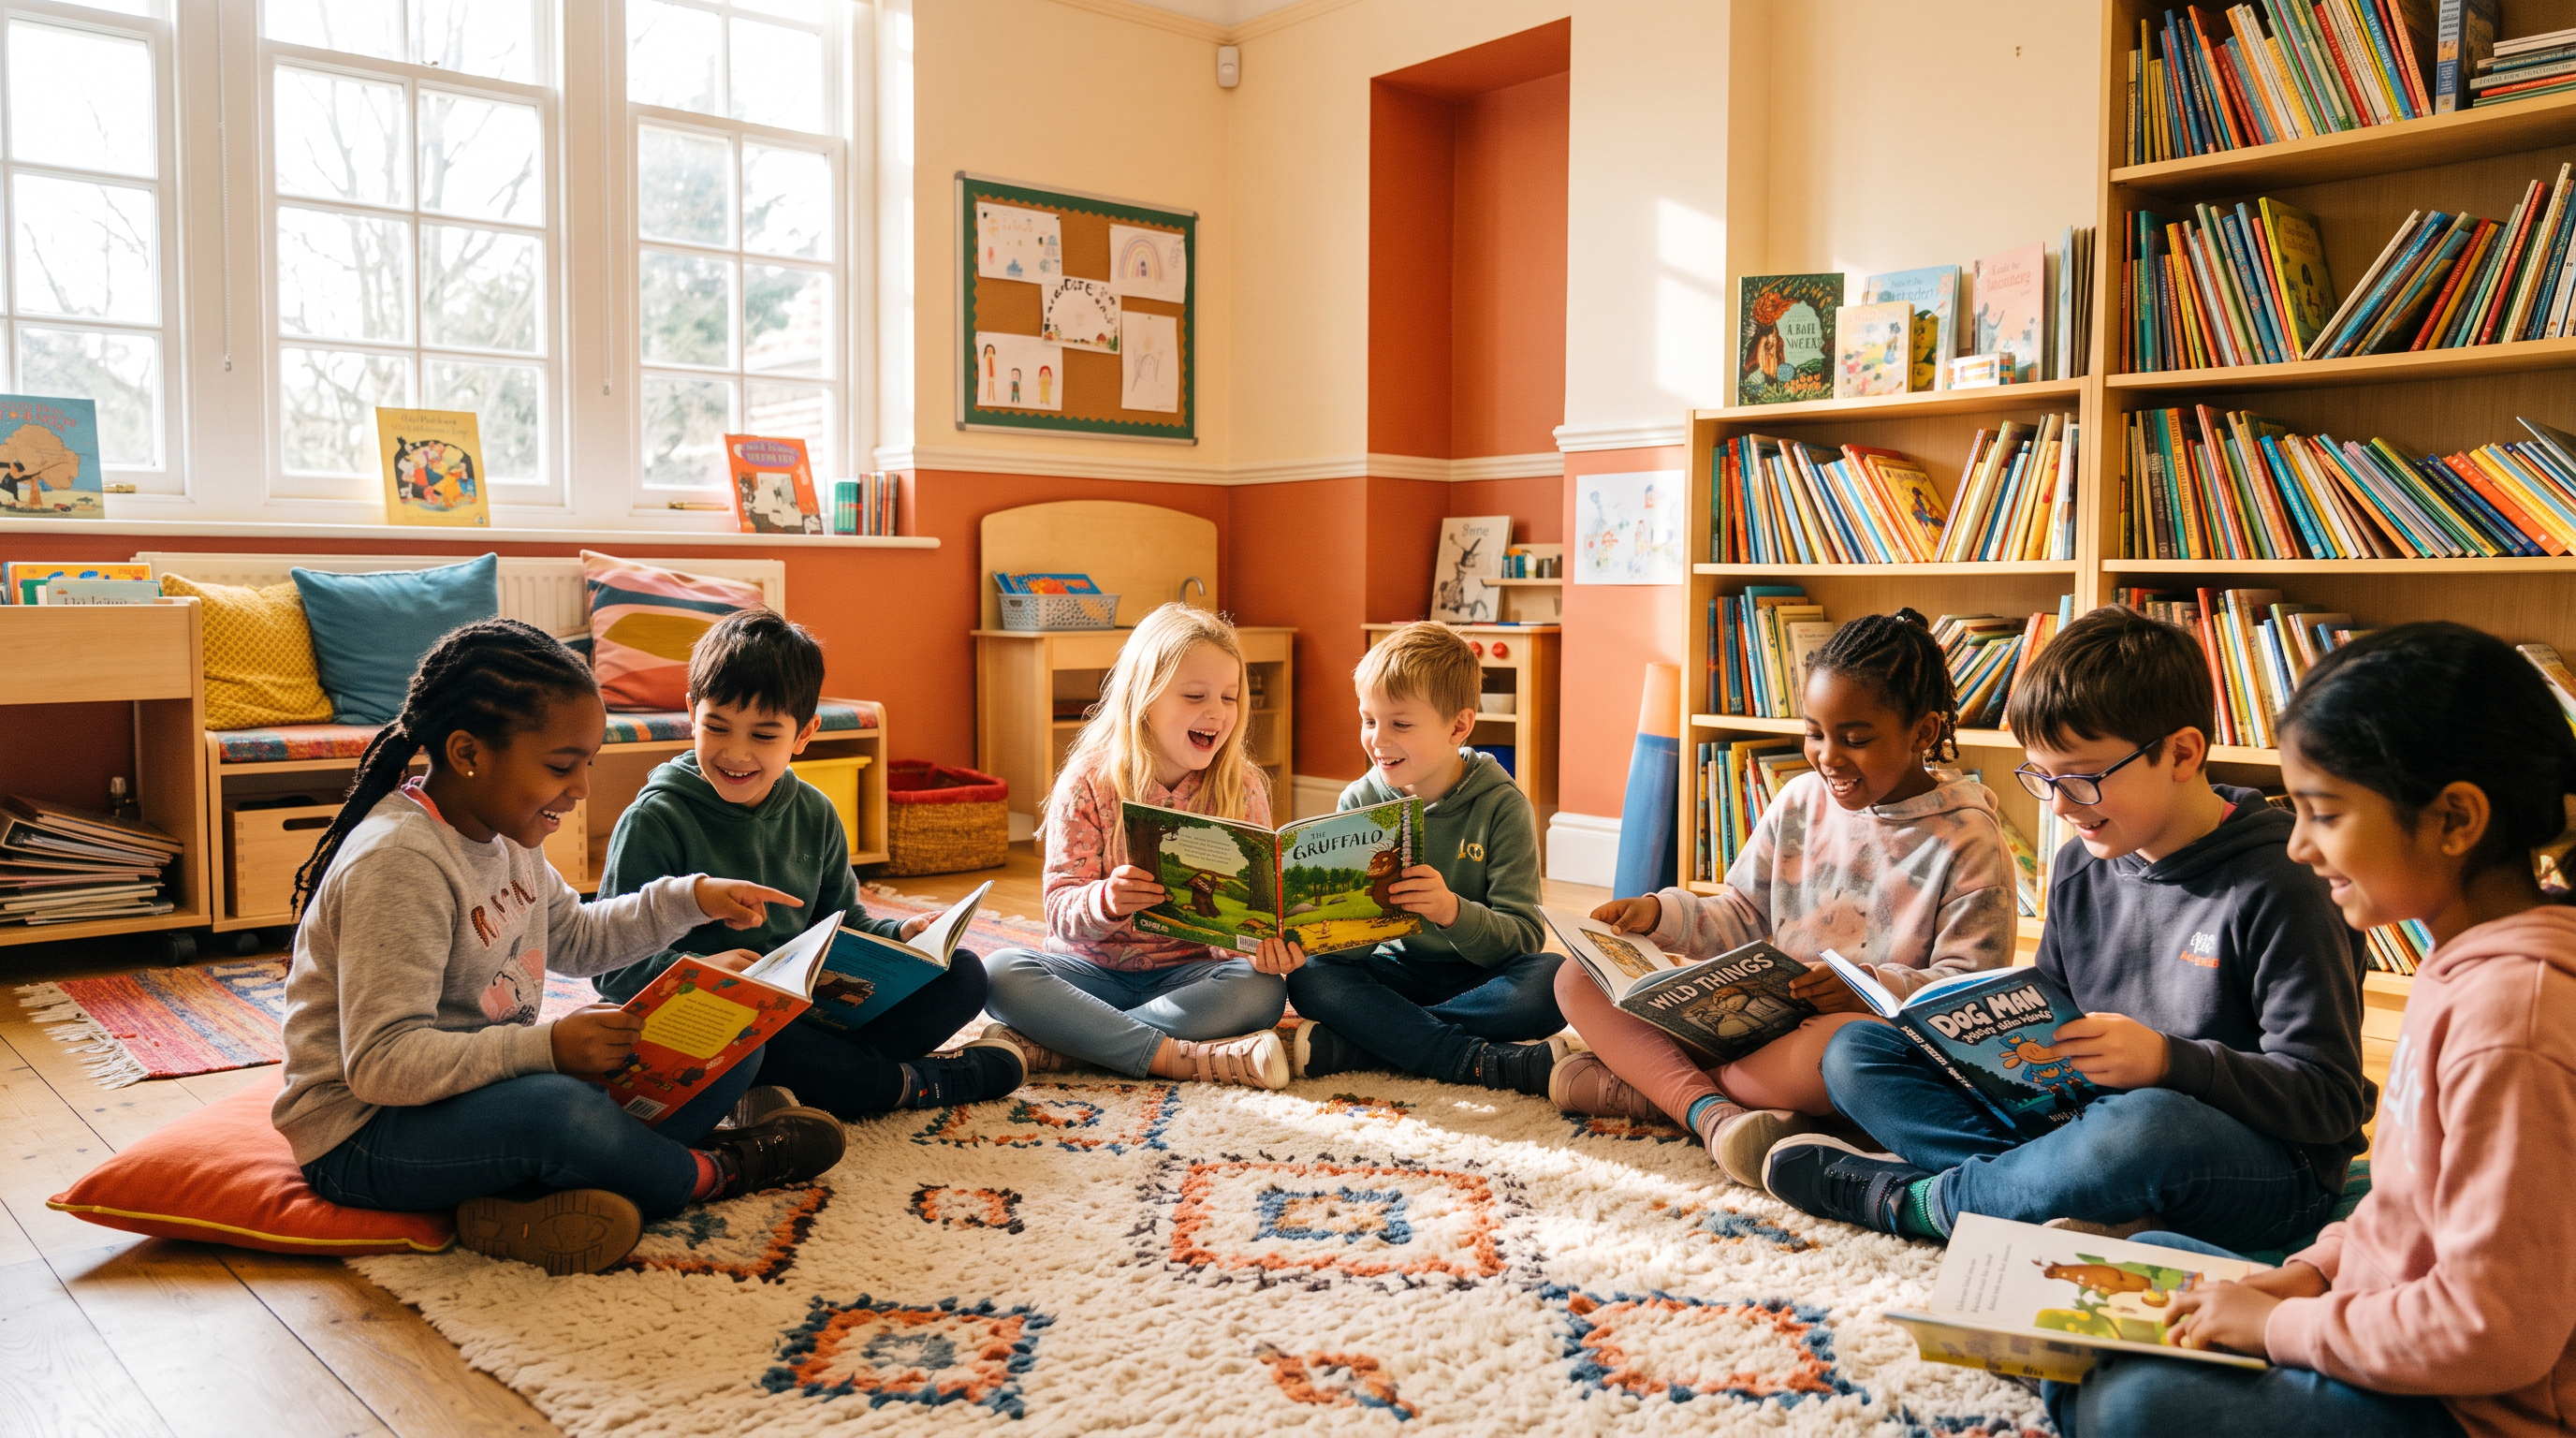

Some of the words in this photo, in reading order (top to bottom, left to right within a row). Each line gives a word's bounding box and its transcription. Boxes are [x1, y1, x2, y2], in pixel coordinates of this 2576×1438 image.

[1293, 829, 1383, 860] GRUFFALO
[1647, 985, 1699, 1010] WILD
[1692, 952, 1774, 991] THINGS
[1927, 1003, 1994, 1039] DOG
[1985, 985, 2047, 1019] MAN
